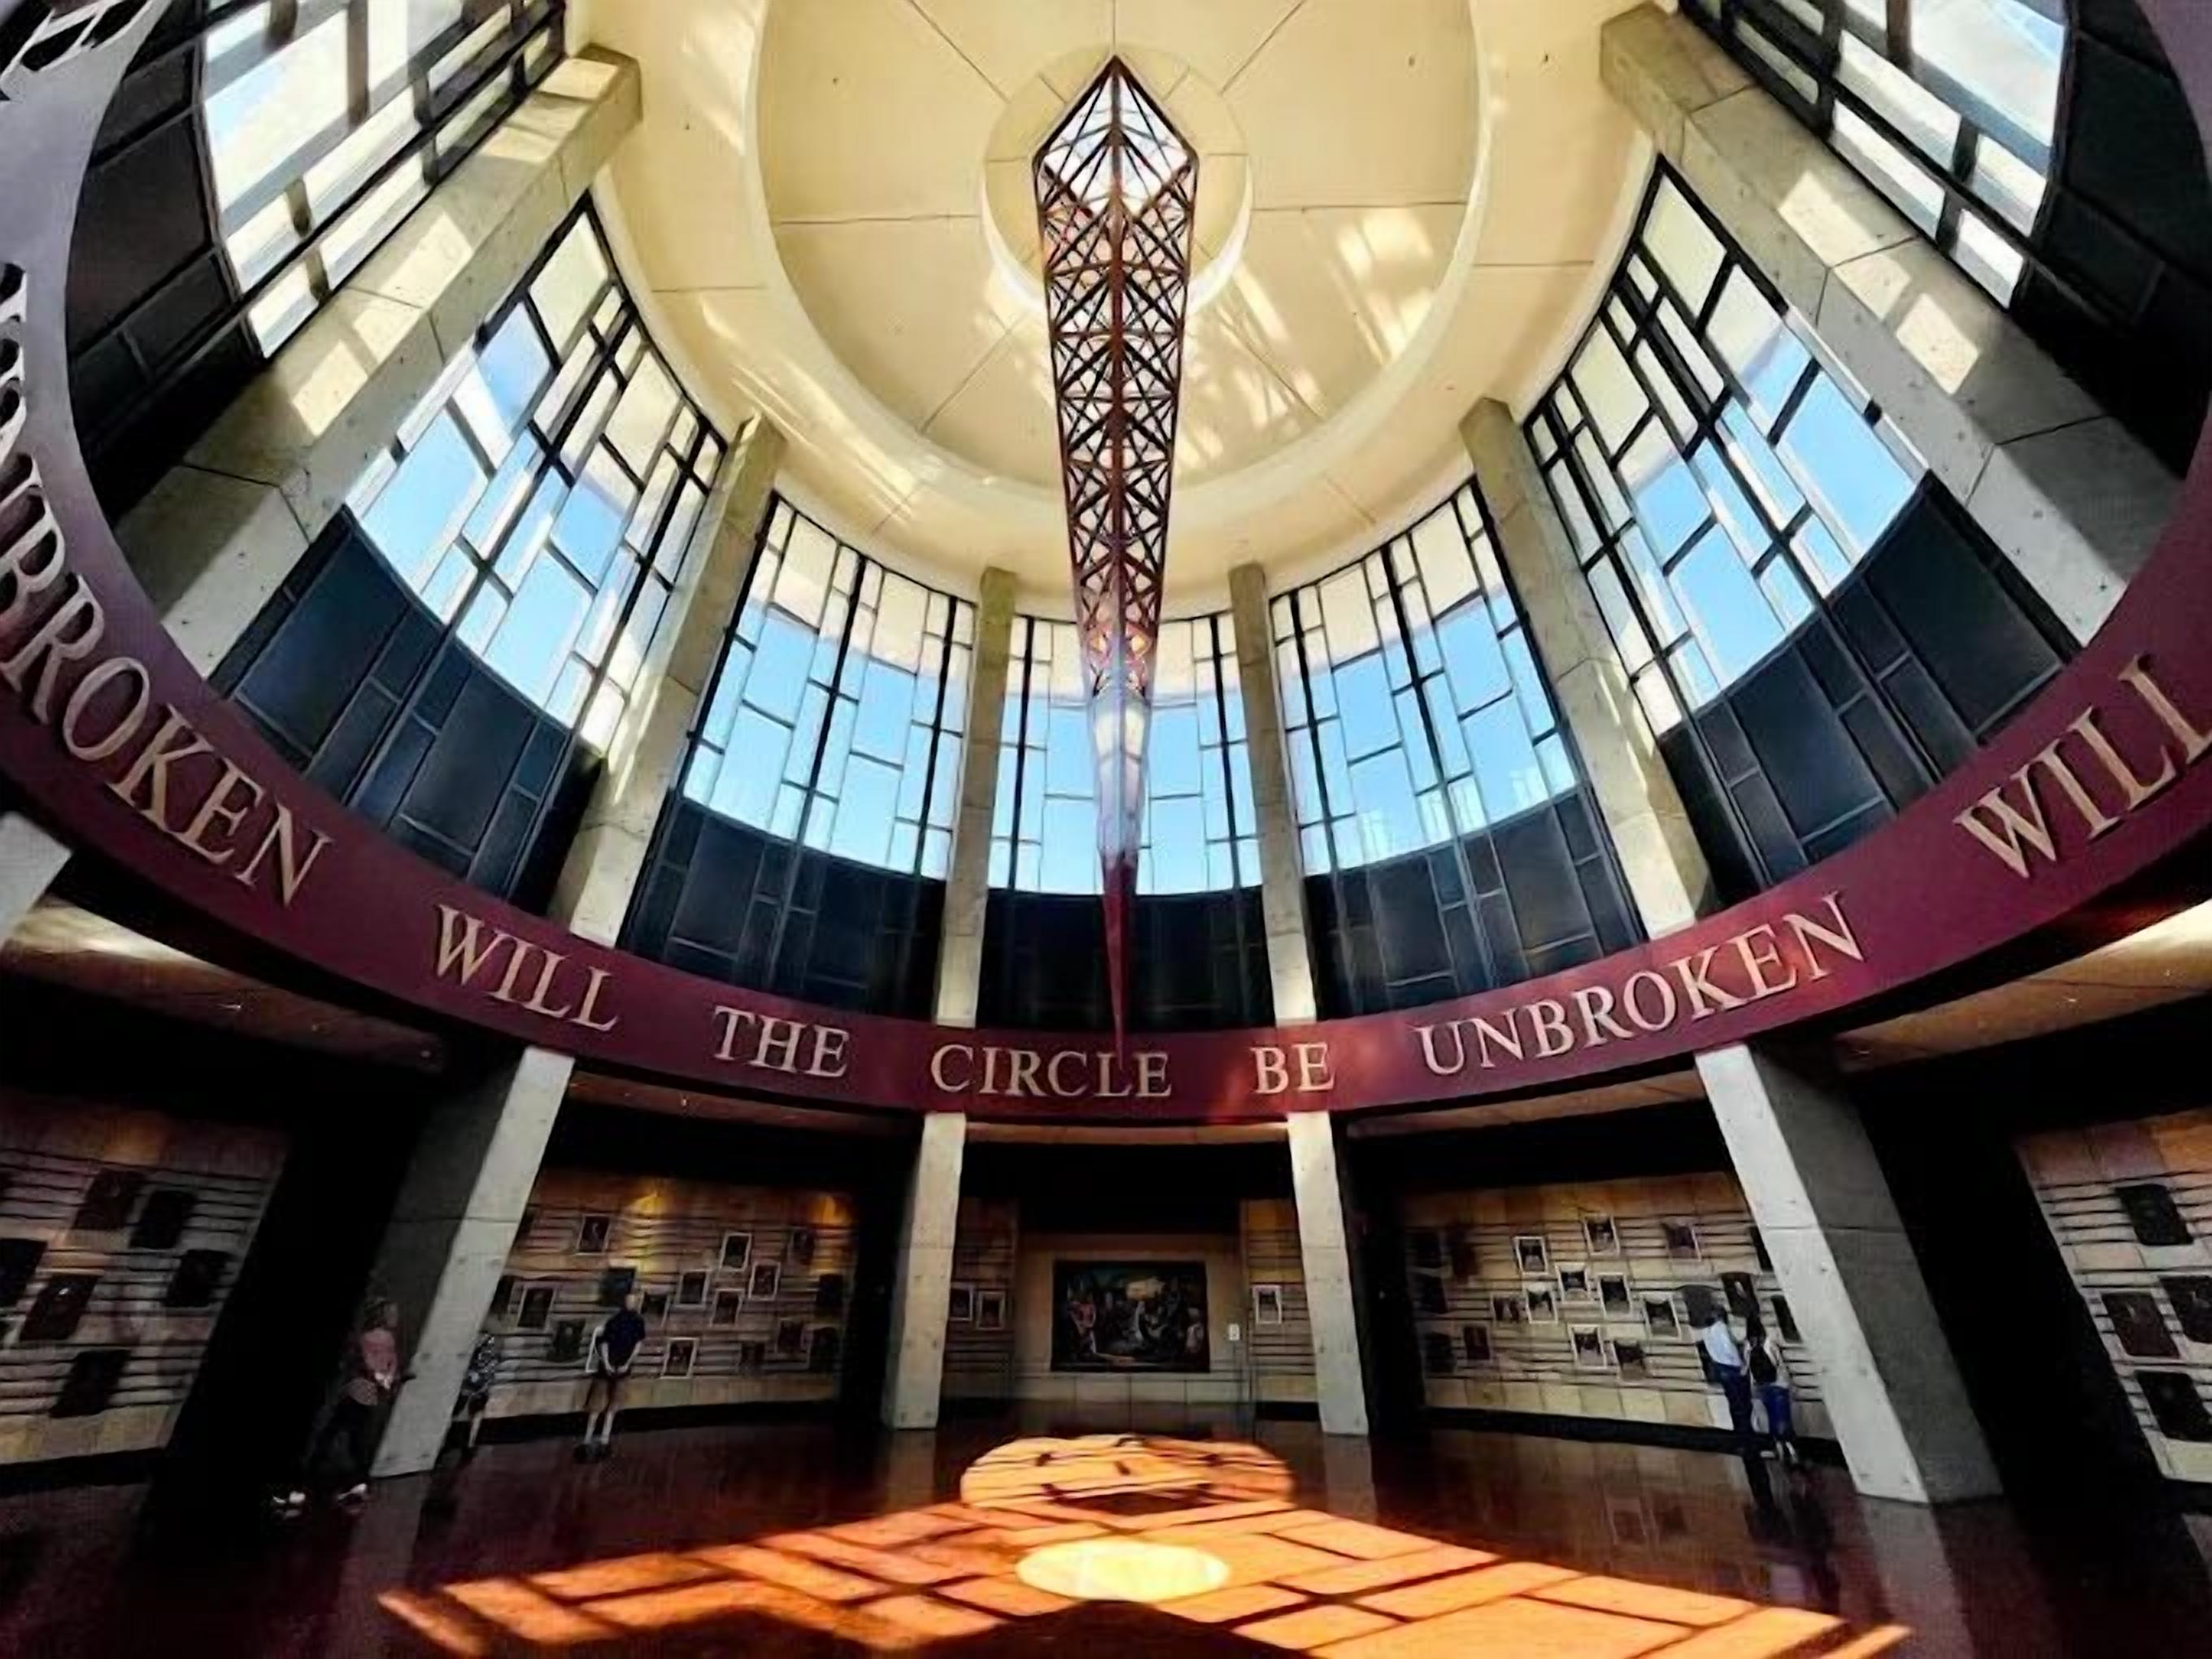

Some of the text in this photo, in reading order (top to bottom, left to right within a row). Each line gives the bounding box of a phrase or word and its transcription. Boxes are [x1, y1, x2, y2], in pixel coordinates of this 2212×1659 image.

[435, 904, 618, 1032] WILL
[714, 1005, 850, 1078] THE
[930, 1044, 1171, 1098] CIRCLE
[1249, 1041, 1335, 1095] BE
[1411, 890, 1867, 1075] UNBROKEN
[1952, 653, 2212, 879] WILL
